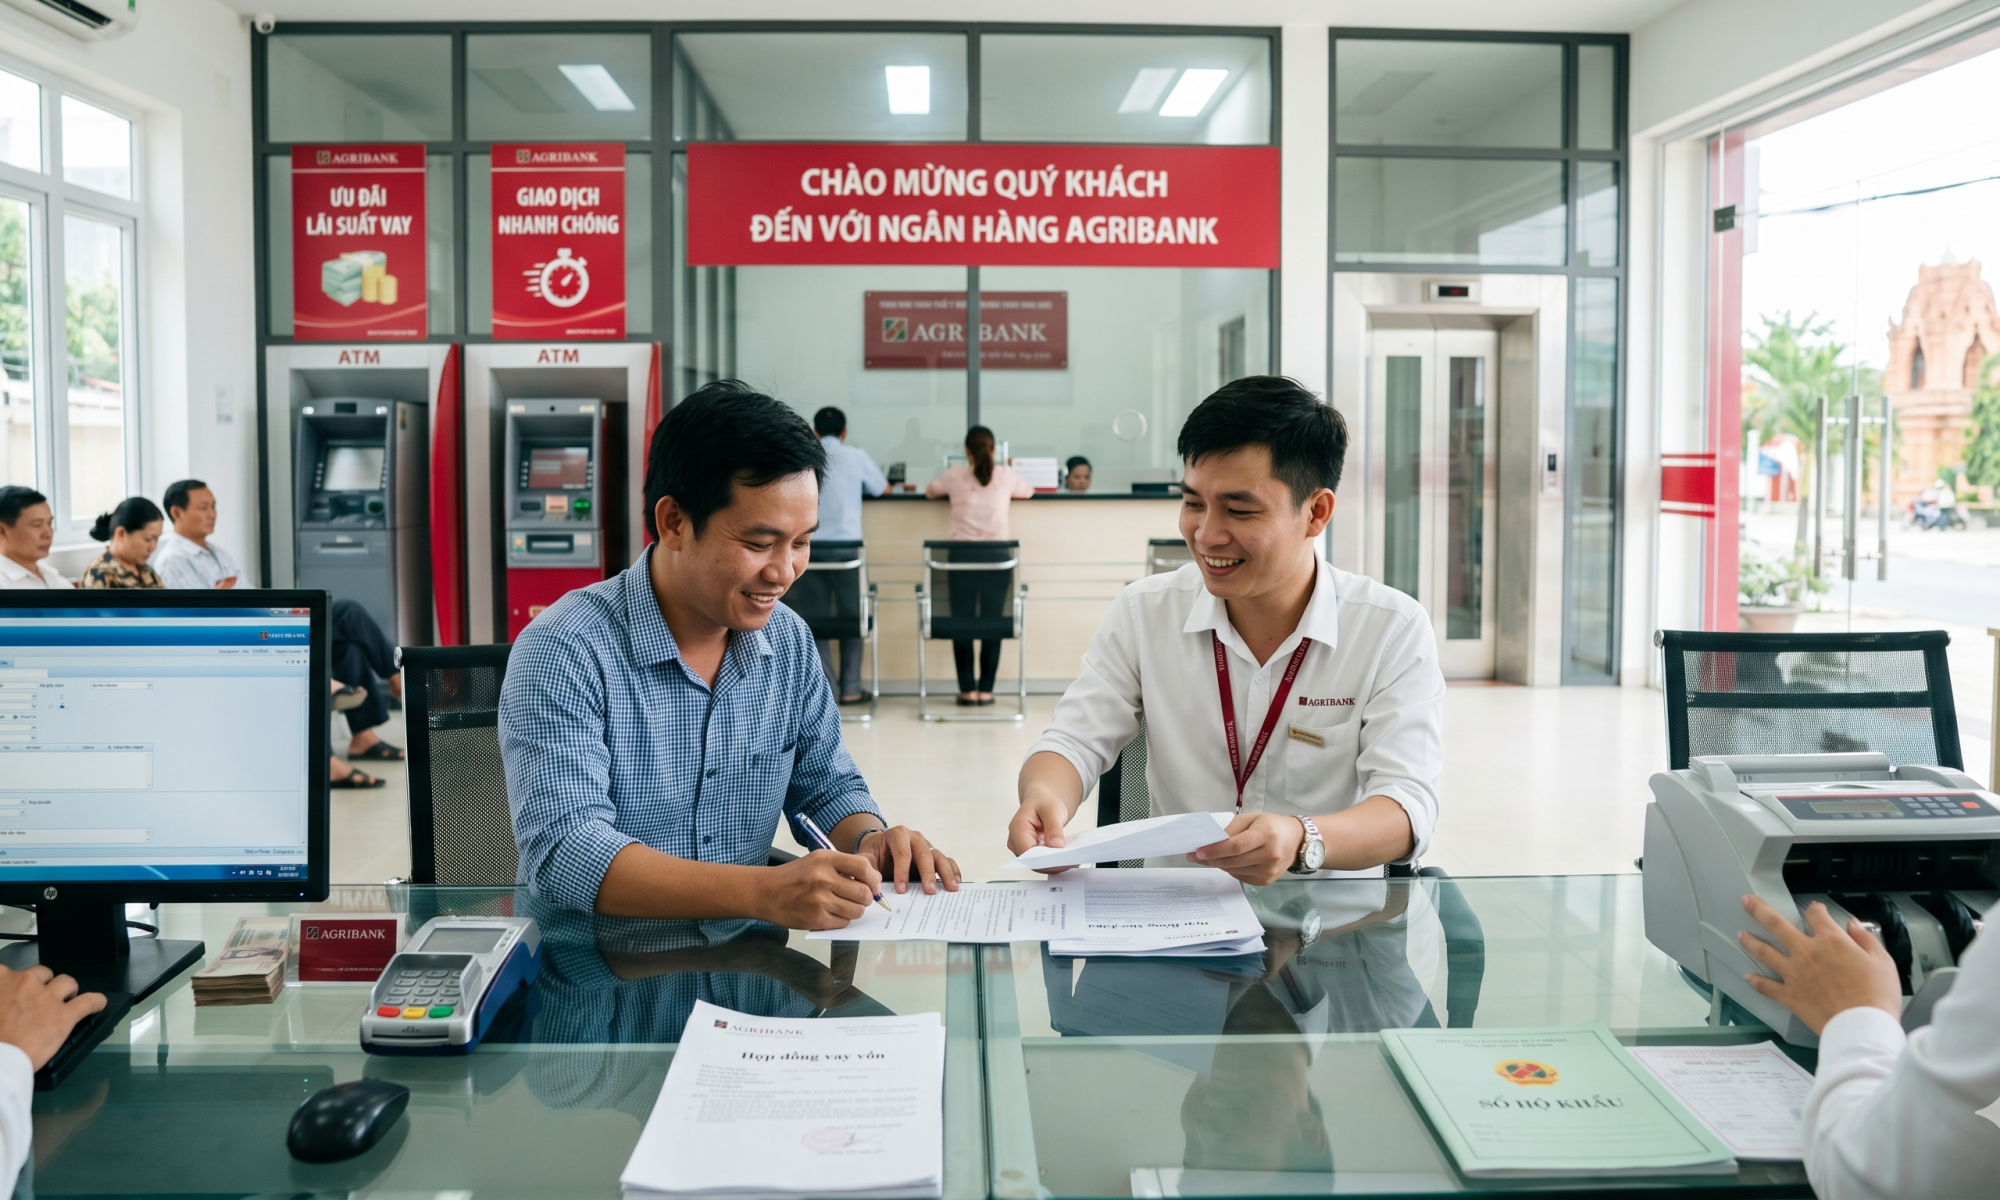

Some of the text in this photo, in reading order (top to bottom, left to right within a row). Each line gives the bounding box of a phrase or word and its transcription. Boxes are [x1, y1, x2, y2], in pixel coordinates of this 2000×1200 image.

[332, 152, 399, 165] AGRIBANK
[532, 151, 599, 164] AGRIBANK
[801, 162, 1169, 201] CHÀO MỪNG QUÝ KHÁCH
[330, 183, 387, 208] ƯU ĐÃI
[516, 186, 600, 211] GIAO DỊCH
[306, 208, 413, 236] LÃI SUẤT VAY
[498, 210, 620, 235] NHANH CHÓNG
[750, 206, 1220, 245] ĐẾN VỚI NGÂN HÀNG AGRIBANK
[912, 323, 1048, 342] AGRBANK
[339, 350, 381, 365] ATM
[537, 349, 580, 364] ATM
[1308, 697, 1355, 707] AGRIBANK
[320, 929, 386, 940] AGRIBANK
[741, 1050, 886, 1063] Hợp đồng vay vốn
